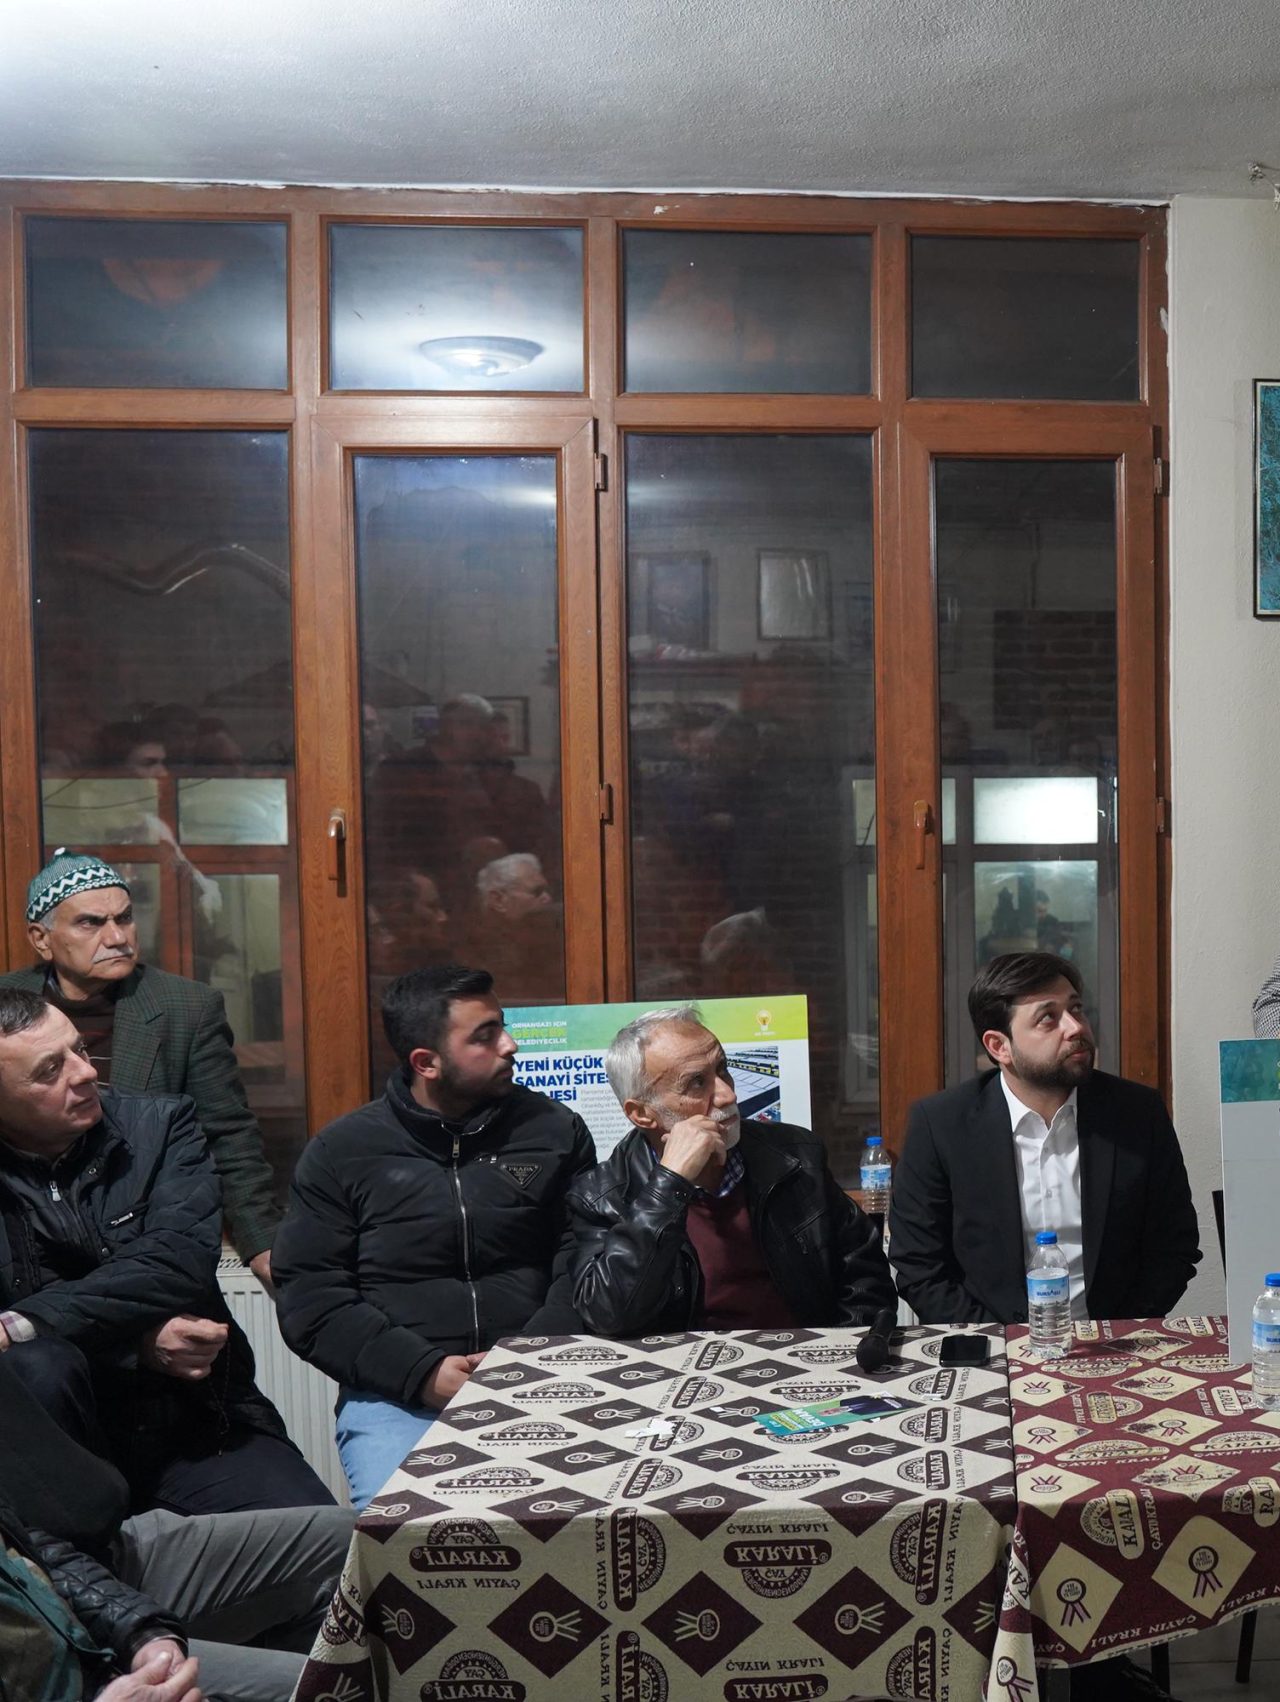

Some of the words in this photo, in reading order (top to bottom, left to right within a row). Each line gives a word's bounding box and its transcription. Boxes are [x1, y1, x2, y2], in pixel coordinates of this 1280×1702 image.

[515, 1057, 549, 1072] YENİ
[553, 1055, 604, 1071] KÜÇÜK
[515, 1072, 570, 1087] SANAYİ
